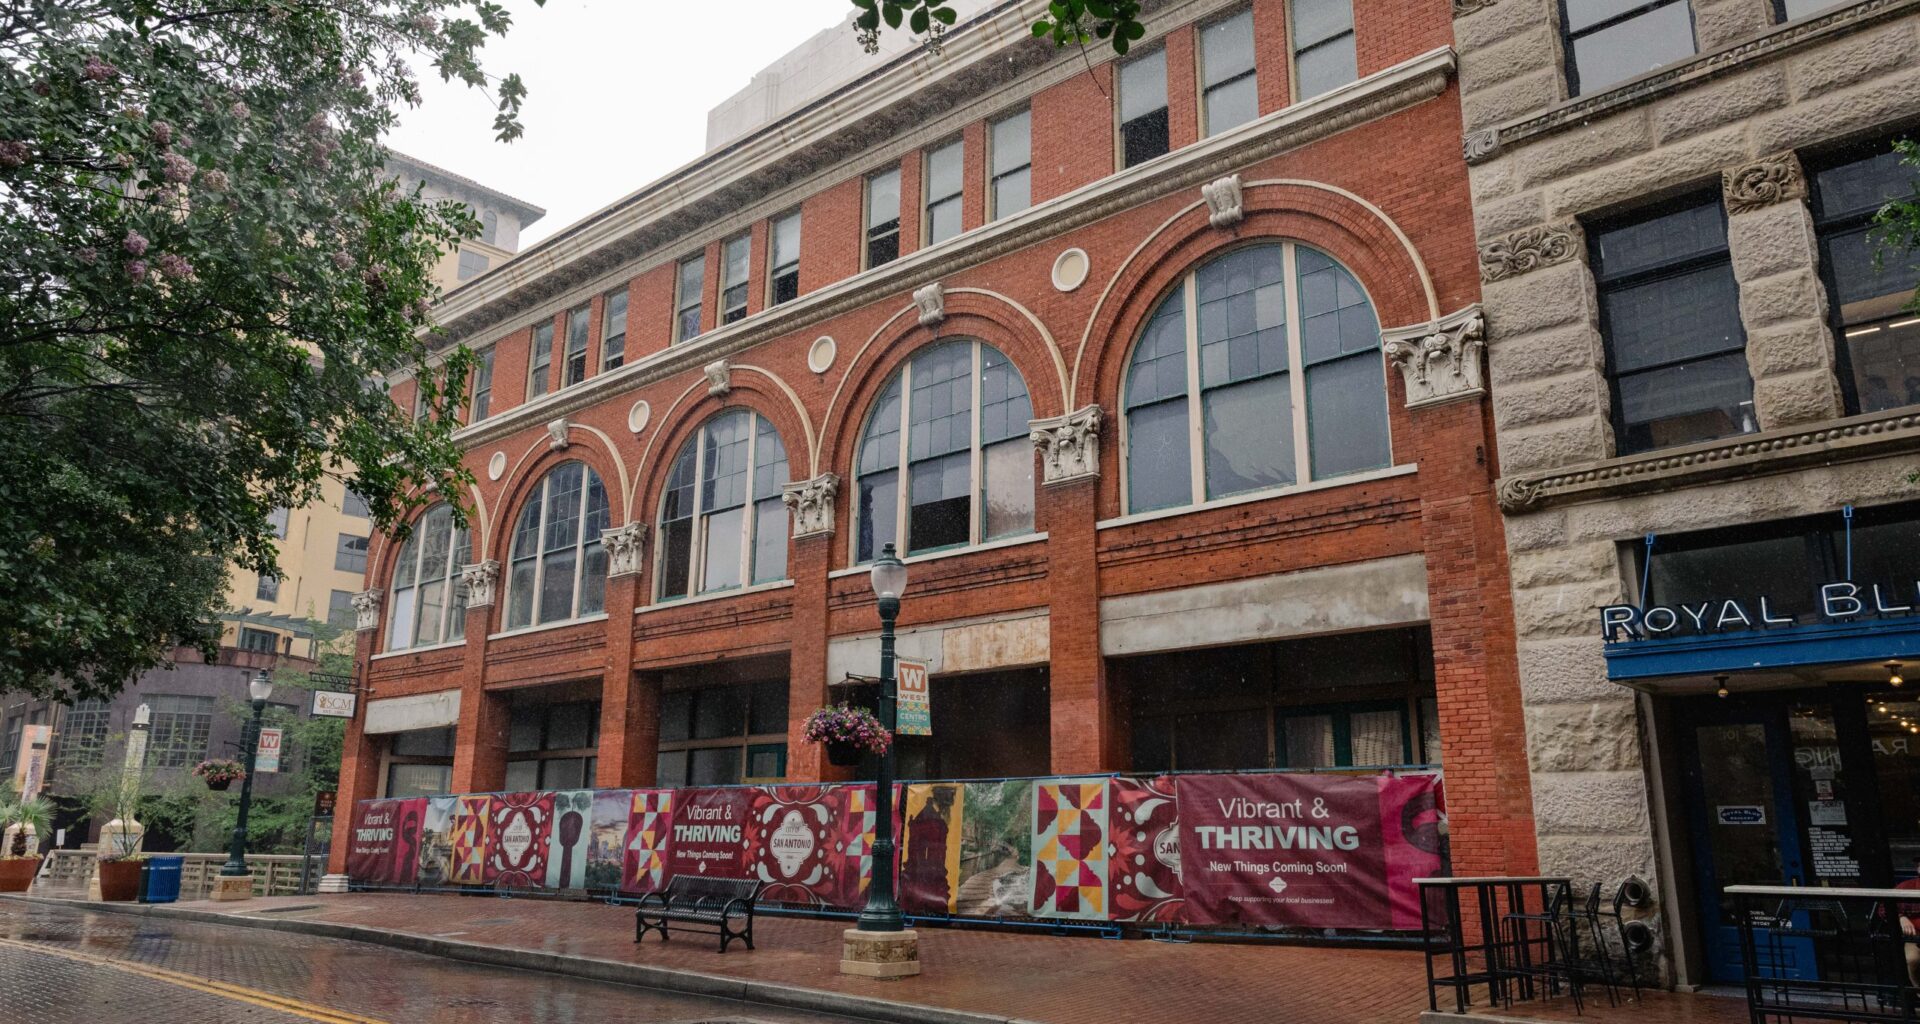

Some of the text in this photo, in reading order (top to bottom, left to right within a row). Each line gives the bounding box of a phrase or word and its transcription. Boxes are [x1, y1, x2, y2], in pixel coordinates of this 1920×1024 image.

[1601, 582, 1920, 638] ROYAL BL
[901, 668, 924, 690] W
[900, 693, 926, 701] WEST
[900, 712, 927, 721] CENTRO
[262, 735, 279, 748] W
[686, 804, 733, 820] Vibrant &
[1218, 796, 1330, 819] Vibrant &
[364, 812, 390, 825] Vibrant &
[356, 828, 394, 842] THRIVING
[674, 825, 741, 843] THRIVING
[1195, 826, 1360, 851] THRIVING
[773, 838, 812, 849] SAN ANTONIO
[1160, 842, 1180, 854] SAN
[676, 849, 734, 861] New Things Coming Soon!
[1209, 861, 1347, 875] New Things Coming Soon!
[1301, 897, 1335, 905] businesses!
